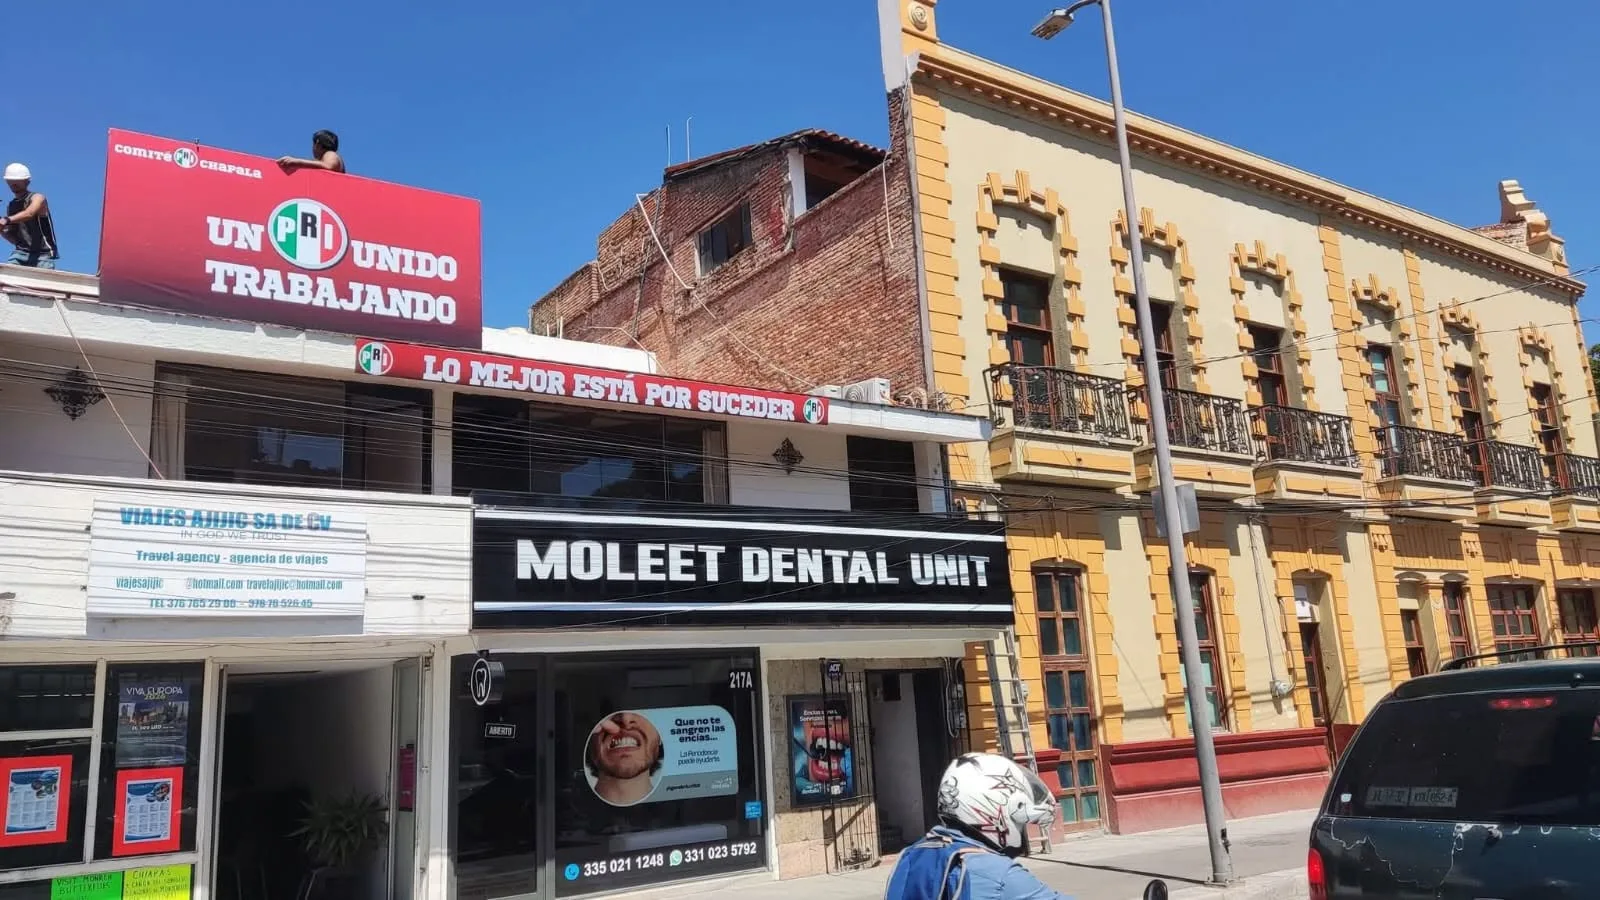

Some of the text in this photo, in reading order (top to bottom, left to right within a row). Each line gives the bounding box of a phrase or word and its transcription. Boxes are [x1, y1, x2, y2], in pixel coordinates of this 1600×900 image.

[206, 211, 457, 282] UN PRI UNIDO
[205, 259, 457, 325] TRABAJANDO
[362, 347, 388, 367] PRI
[423, 355, 795, 421] LO MEJOR ESTÁ POR SUCEDER
[120, 507, 332, 531] VIAJES AJIJIC SA DE CV
[180, 530, 288, 541] IN GOD WE TRUST
[136, 550, 174, 562] Travel
[176, 552, 221, 564] agency
[229, 553, 276, 565] agencia
[278, 554, 293, 565] de
[295, 554, 329, 566] viajes
[516, 539, 990, 587] MOLEET DENTAL UNIT
[116, 576, 164, 590] viajesajijic
[149, 598, 165, 608] TEL
[167, 598, 185, 608] 376
[208, 598, 221, 609] 29
[829, 663, 841, 673] ADT
[729, 671, 753, 689] 217A
[126, 686, 183, 696] VIVA EUROPA
[674, 717, 721, 727] Que no te
[488, 726, 513, 736] ABIERTO
[670, 726, 710, 736] sangren
[583, 842, 757, 877] 335 021 1248 331 023 5792
